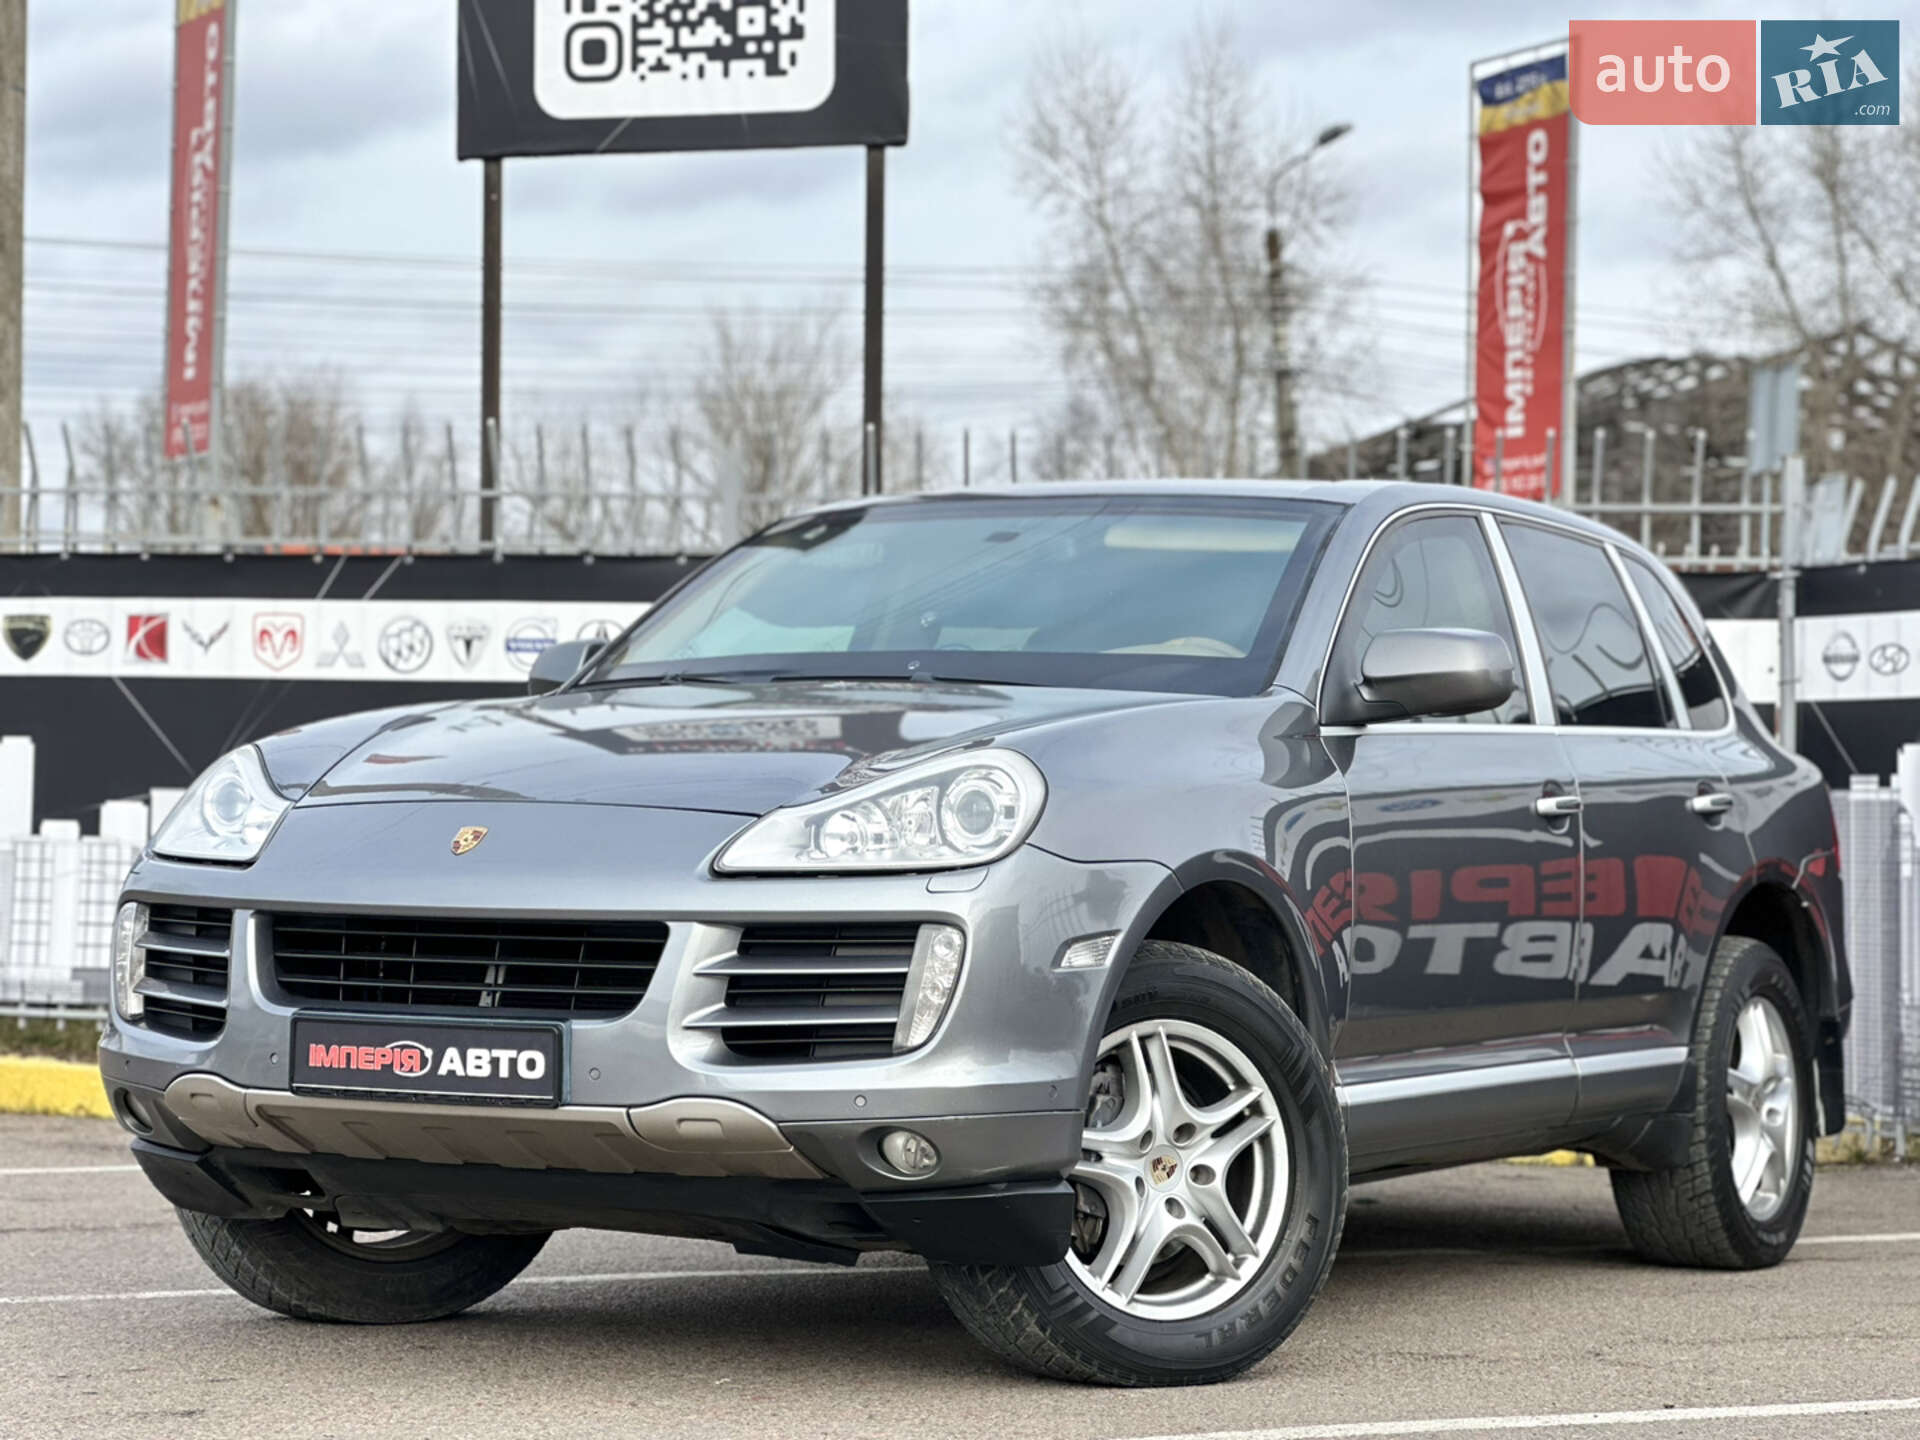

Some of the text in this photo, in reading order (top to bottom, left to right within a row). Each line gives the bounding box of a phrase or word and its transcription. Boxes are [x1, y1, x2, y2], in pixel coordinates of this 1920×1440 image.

[1527, 128, 1549, 258] АВТО
[308, 1043, 546, 1080] ІМПЕРІЯ АВТО
